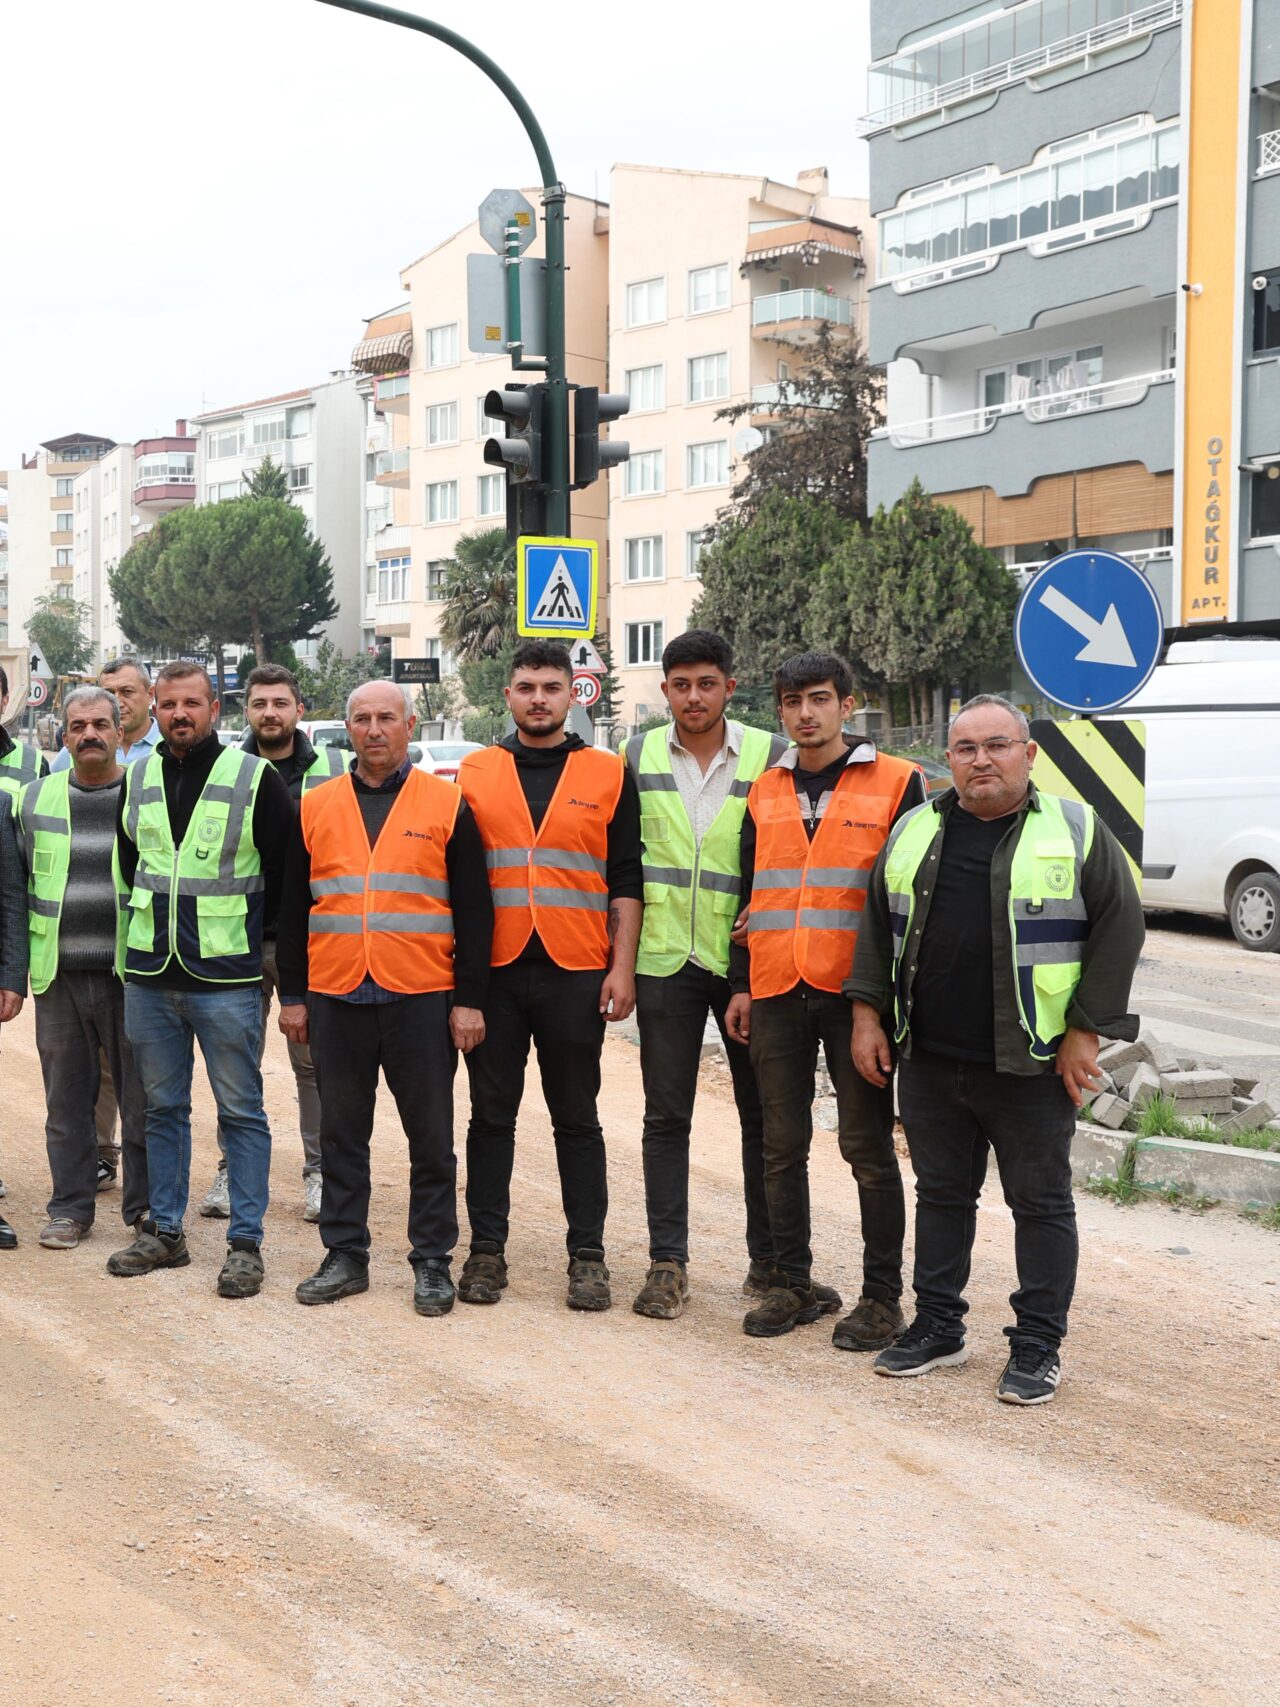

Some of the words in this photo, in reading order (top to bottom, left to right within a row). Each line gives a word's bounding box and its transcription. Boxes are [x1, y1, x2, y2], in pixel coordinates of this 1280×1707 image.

[1204, 437, 1224, 584] OTAĞKUR
[1192, 596, 1226, 609] APT.
[574, 682, 593, 697] 30
